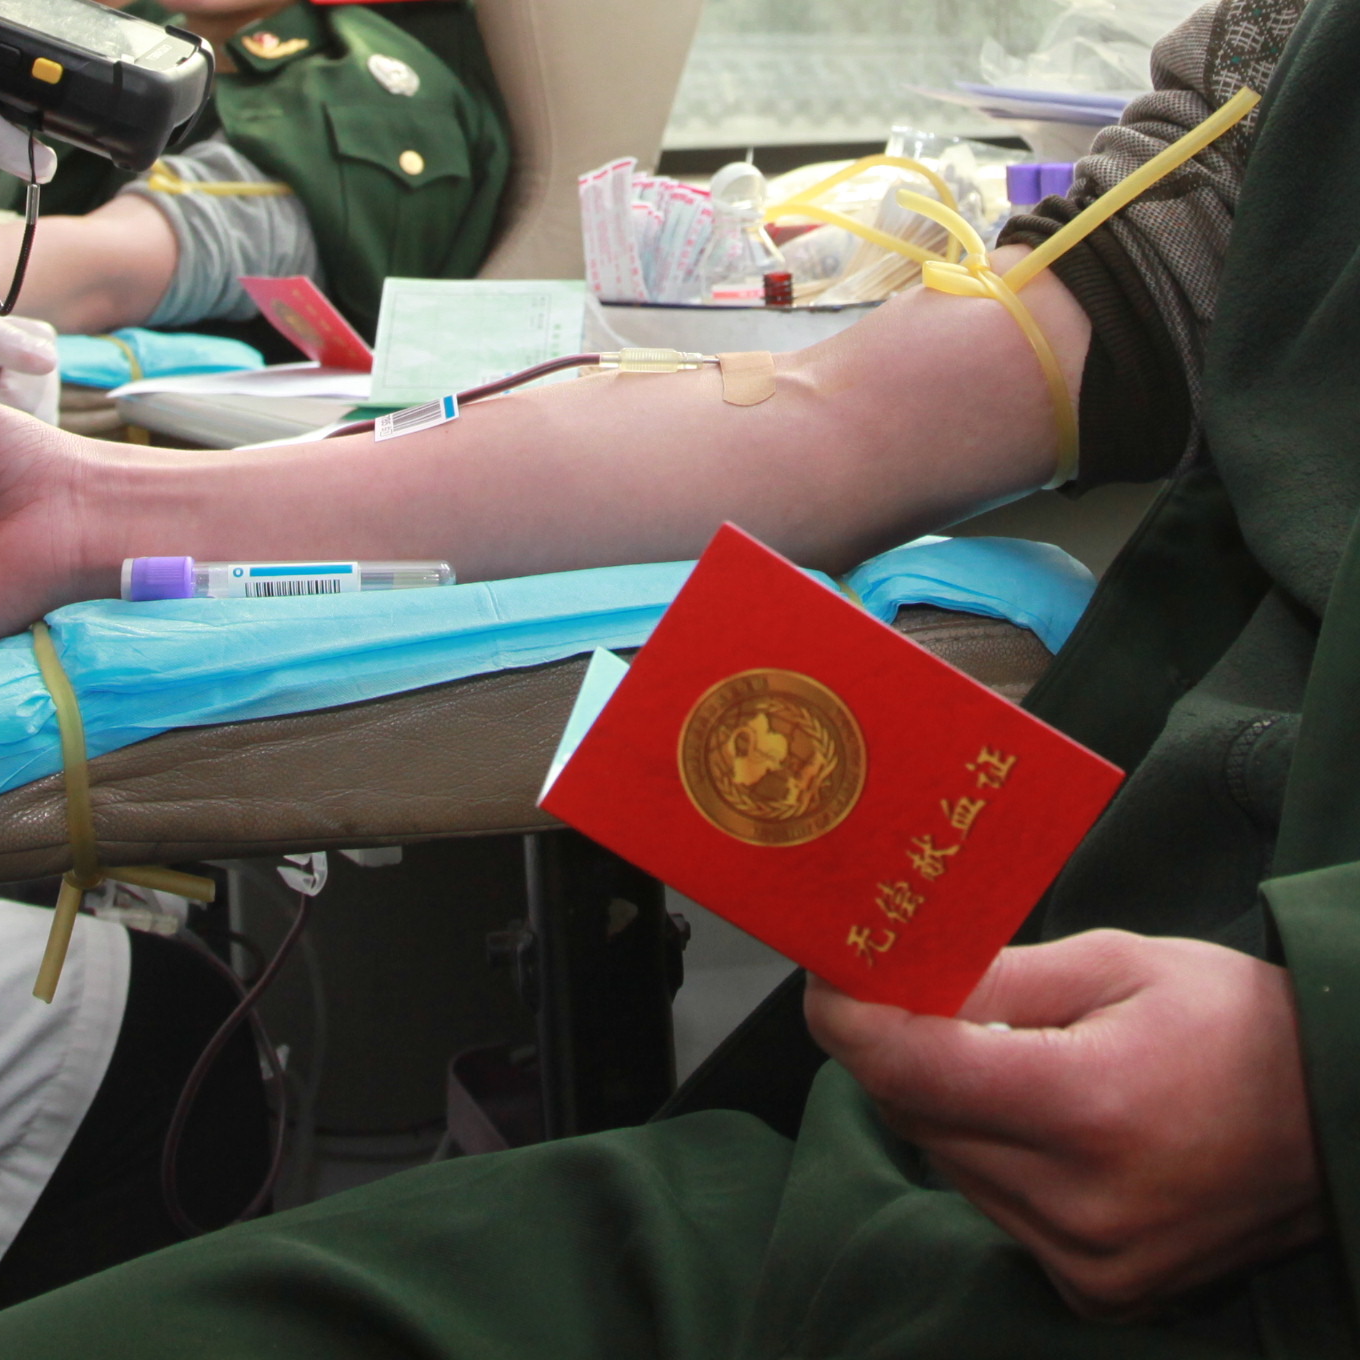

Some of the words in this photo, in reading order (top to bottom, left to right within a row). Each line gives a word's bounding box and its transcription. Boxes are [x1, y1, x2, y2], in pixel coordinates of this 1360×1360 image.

[846, 745, 1017, 968] 无偿献血证
